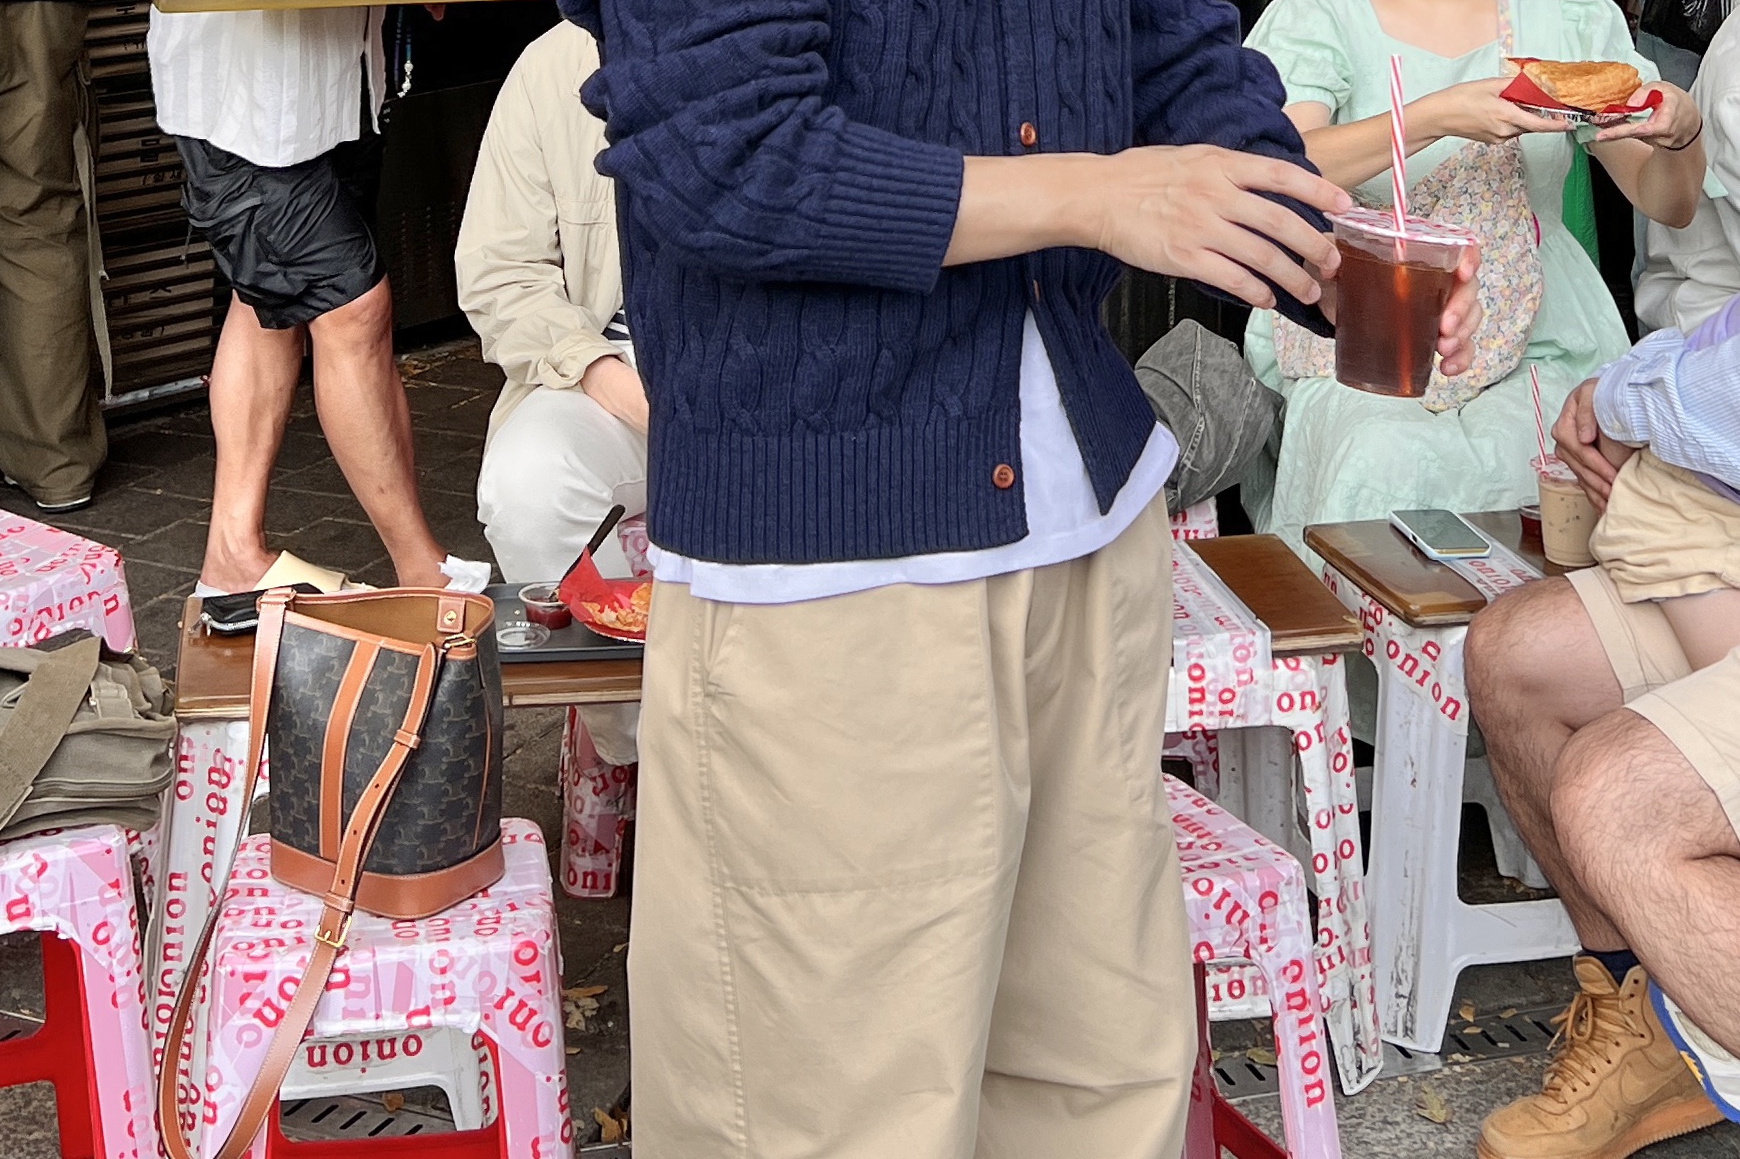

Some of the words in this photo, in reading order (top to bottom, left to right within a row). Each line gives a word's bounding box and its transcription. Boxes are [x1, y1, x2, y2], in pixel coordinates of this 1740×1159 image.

[1386, 639, 1461, 721] onion
[1277, 690, 1317, 713] on
[306, 1034, 423, 1073] onion
